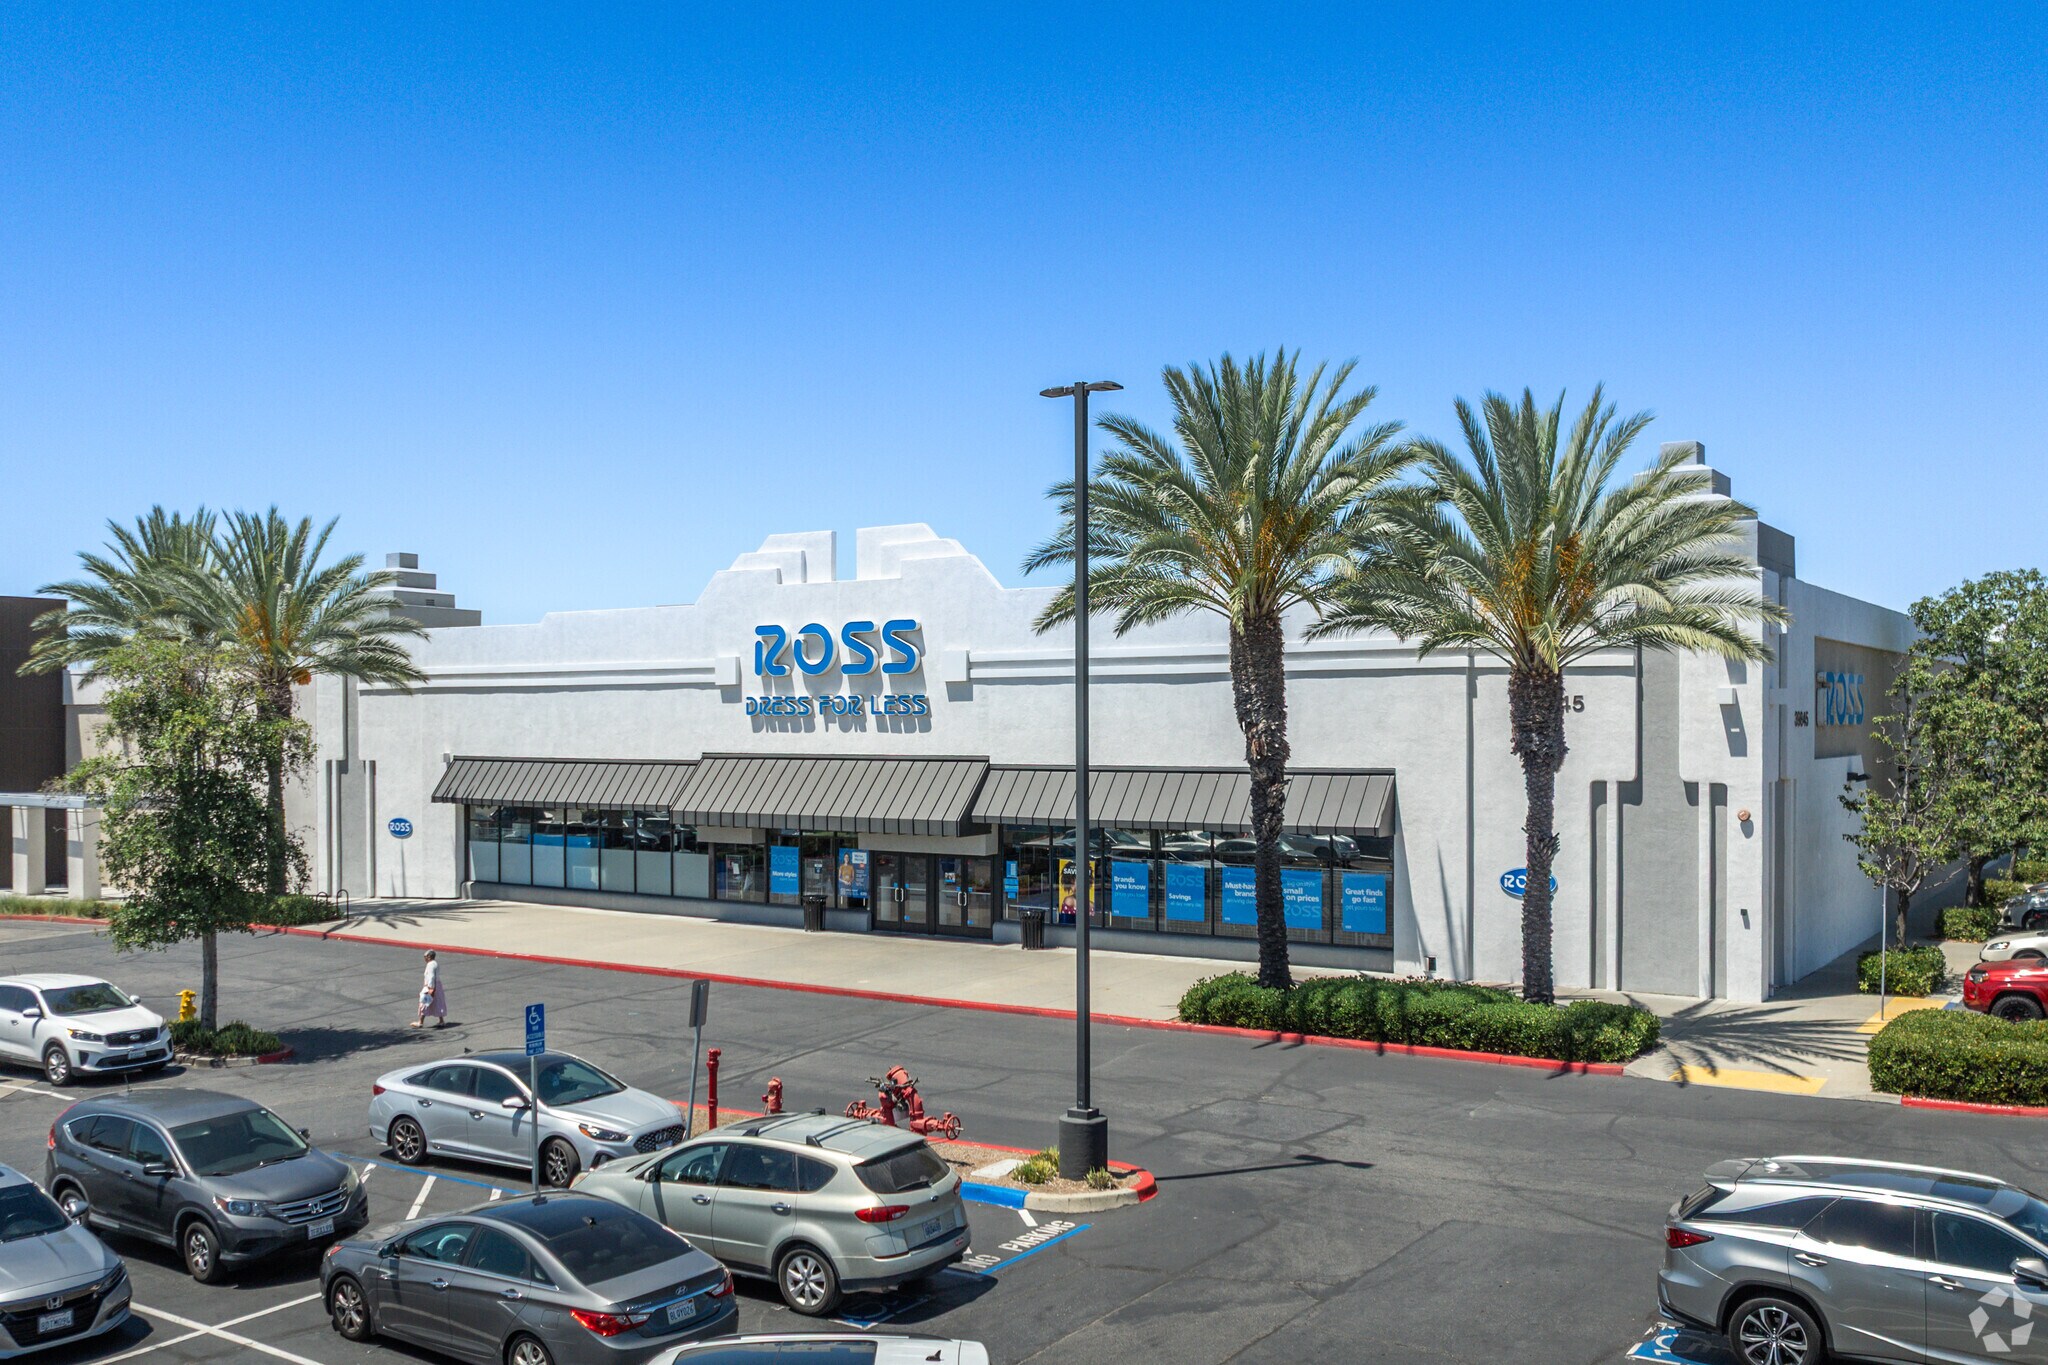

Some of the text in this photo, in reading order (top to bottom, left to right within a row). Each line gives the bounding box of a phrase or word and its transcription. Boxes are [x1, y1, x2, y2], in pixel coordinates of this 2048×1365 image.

[755, 619, 917, 676] ROSS
[1824, 671, 1866, 726] ROSS
[746, 694, 928, 716] DRESS FOR LESS
[390, 822, 411, 832] ROSS
[1167, 873, 1203, 887] ROSS
[1168, 893, 1192, 902] Savings
[1297, 894, 1319, 902] prices
[1345, 888, 1383, 897] Great finds
[1362, 896, 1377, 904] fast
[962, 1220, 1076, 1269] NO PARKING
